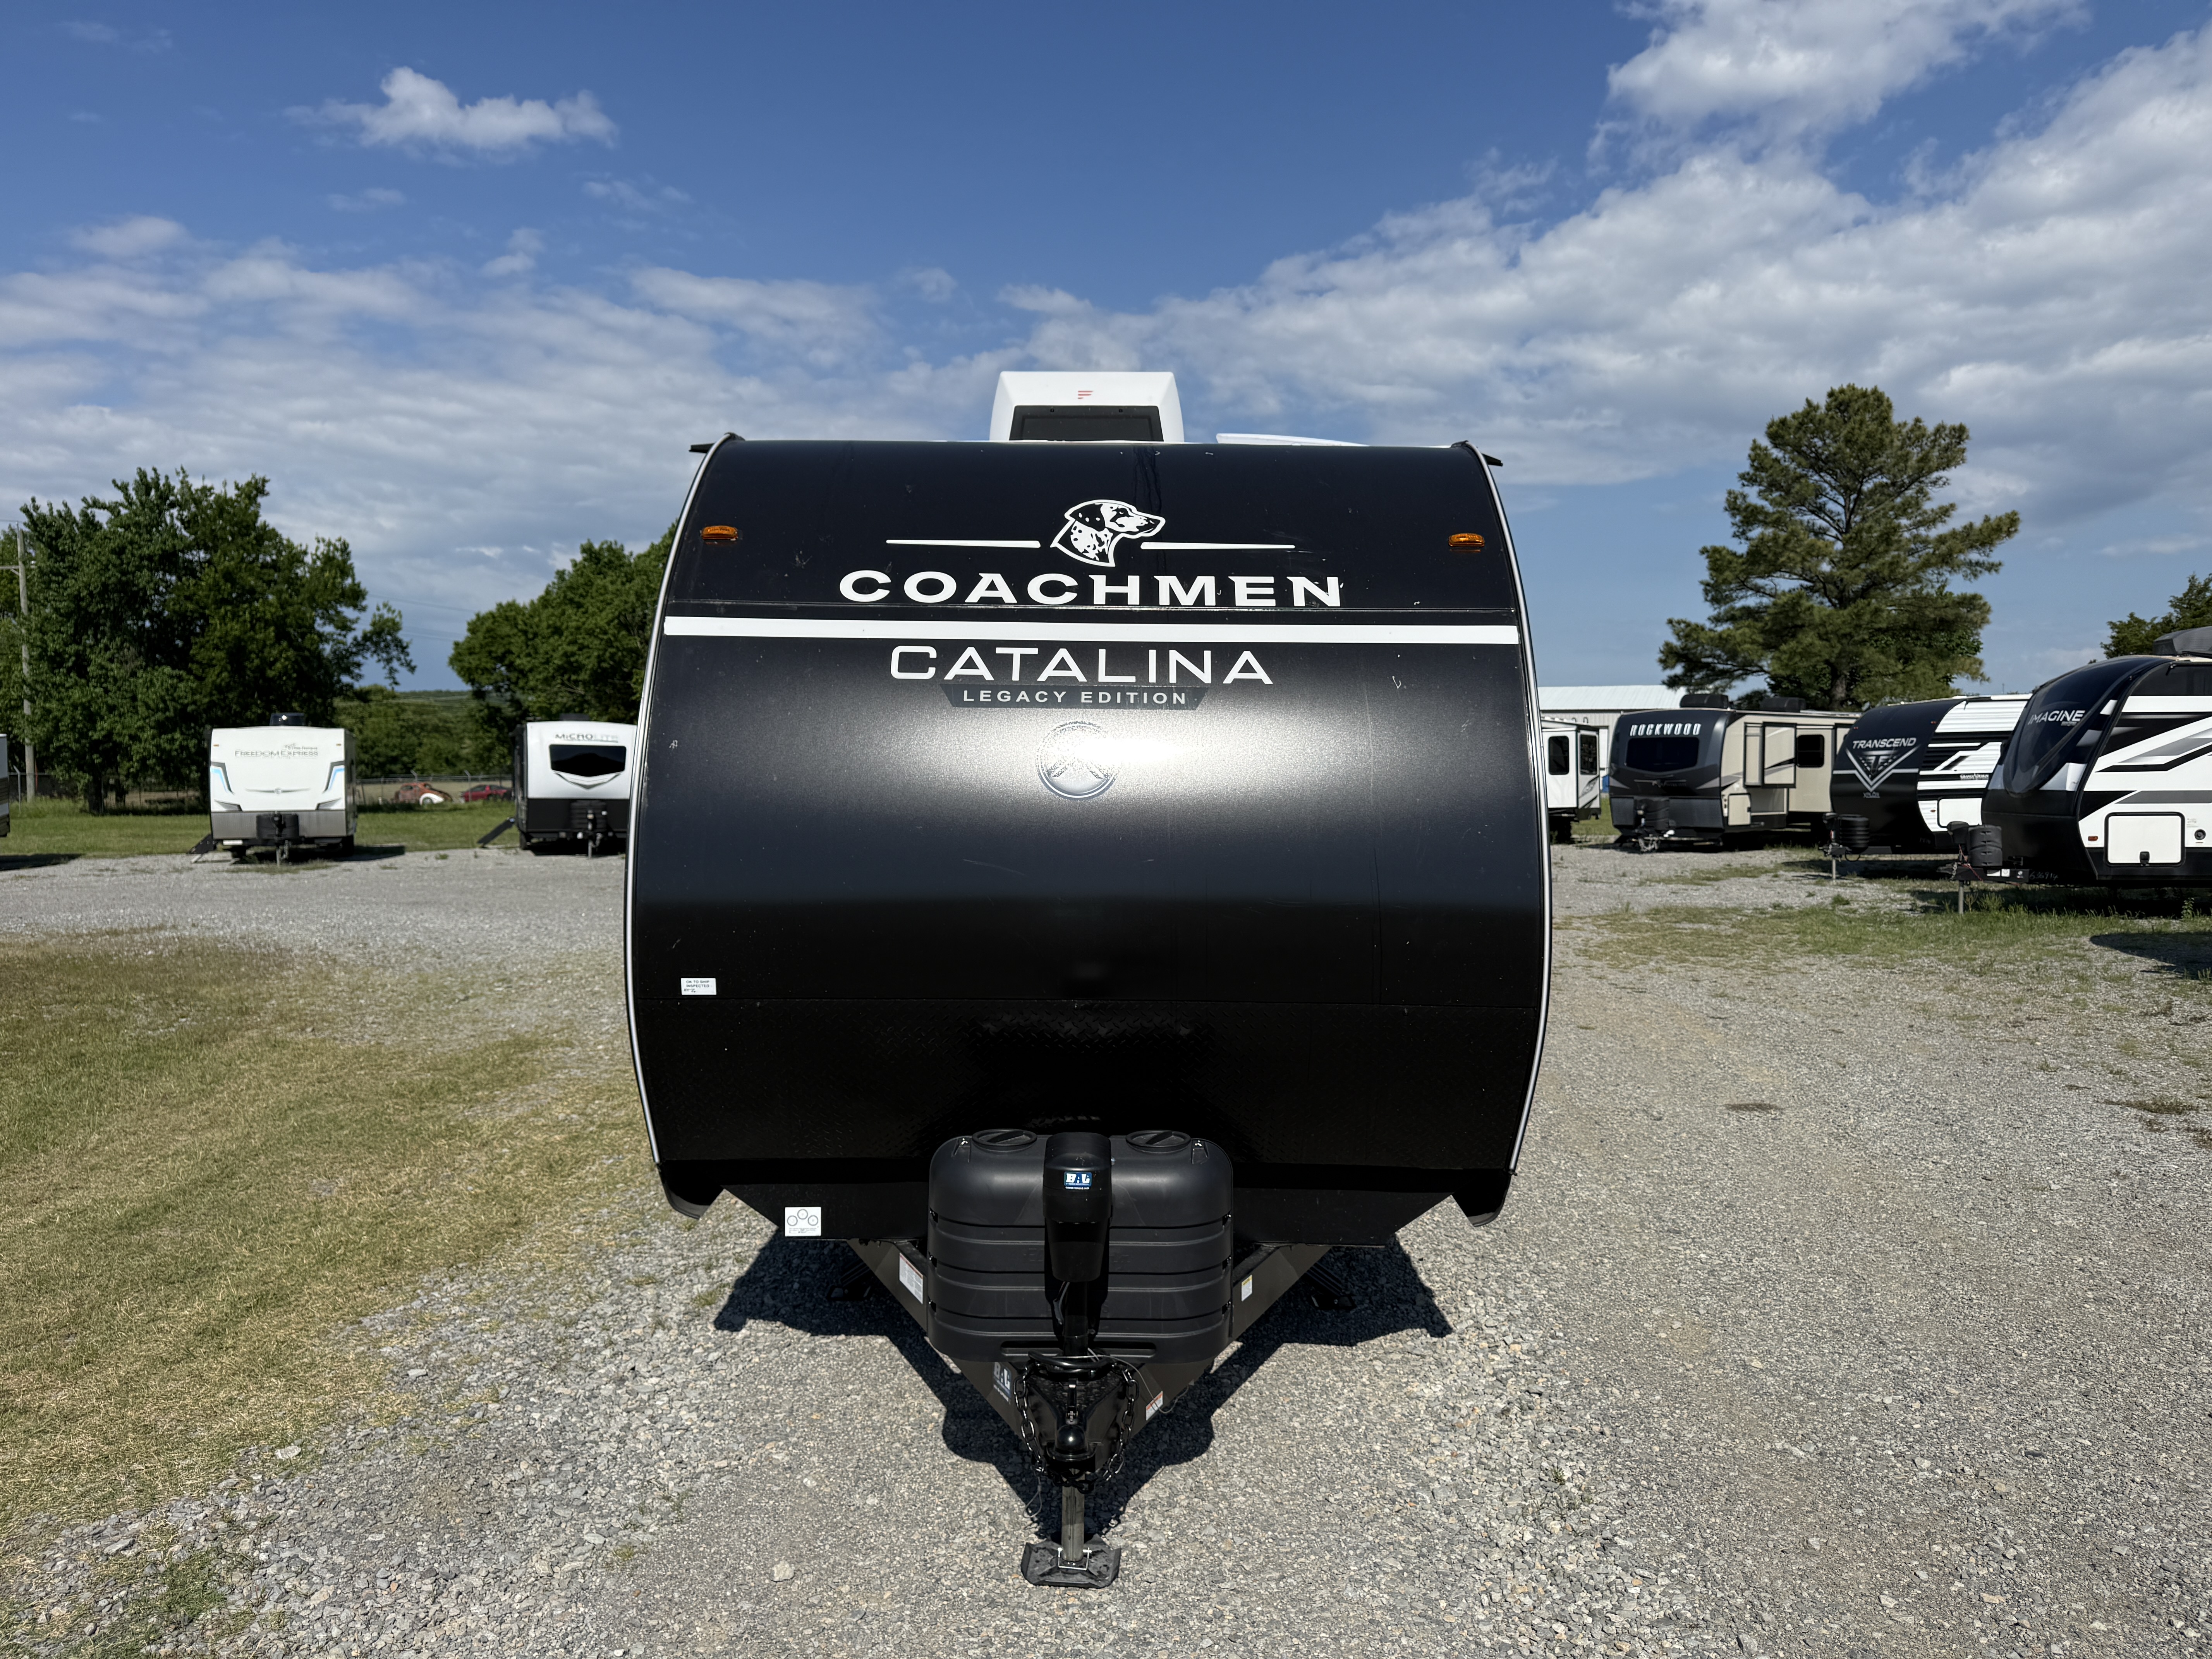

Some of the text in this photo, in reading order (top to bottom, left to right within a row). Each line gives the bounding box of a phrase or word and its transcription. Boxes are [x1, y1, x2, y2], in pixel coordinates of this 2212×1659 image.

[840, 570, 1342, 607] COACHMEN
[891, 645, 1274, 684] CATALINA
[963, 690, 1186, 705] LEGACY EDITION
[2028, 710, 2085, 725] IMAGINE
[1630, 723, 1702, 736] ROCKWOOD
[1852, 737, 1917, 749] TRANSCEND
